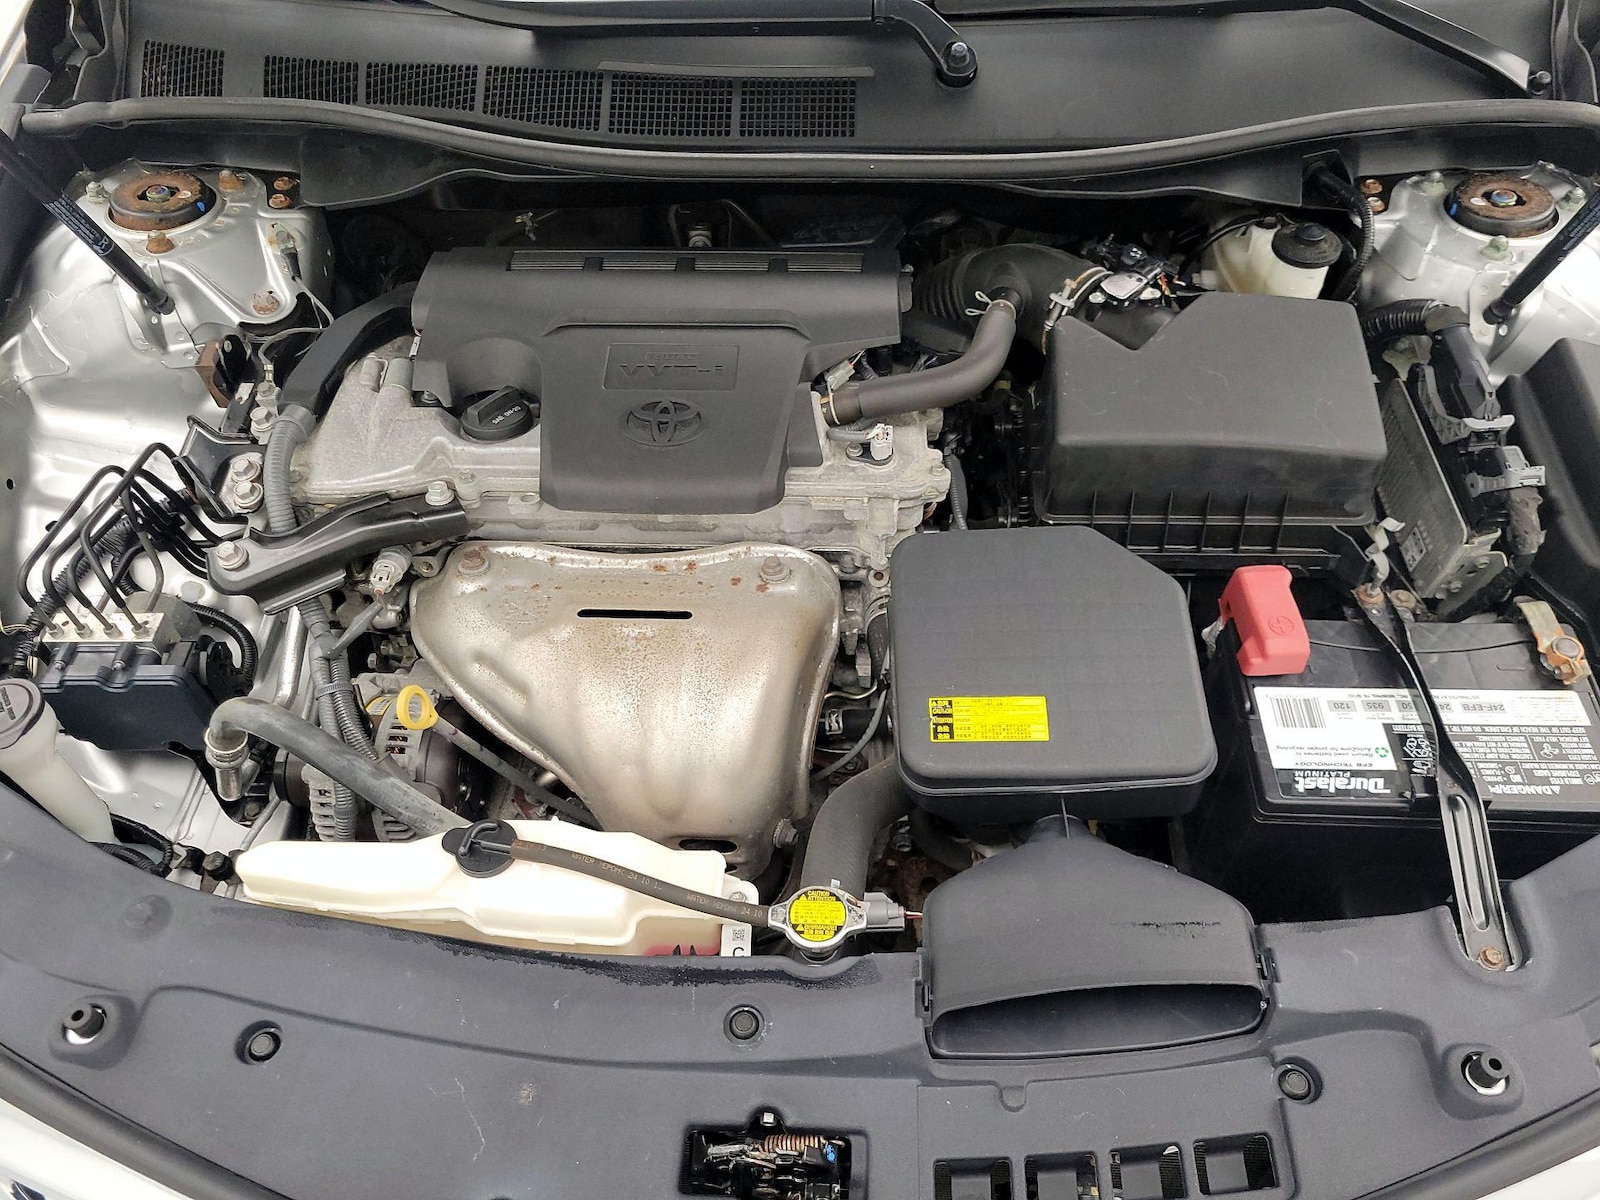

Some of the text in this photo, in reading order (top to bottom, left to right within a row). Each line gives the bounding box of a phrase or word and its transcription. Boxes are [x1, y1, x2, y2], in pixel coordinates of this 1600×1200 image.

[1333, 702, 1350, 710] 120
[1366, 702, 1384, 710] 935
[1401, 702, 1413, 710] 50
[1294, 777, 1391, 794] Duralast
[571, 852, 596, 865] WATER
[627, 872, 638, 881] 24
[641, 876, 650, 885] 10
[686, 892, 709, 906] WATER
[740, 907, 751, 915] 24
[753, 908, 763, 918] 10
